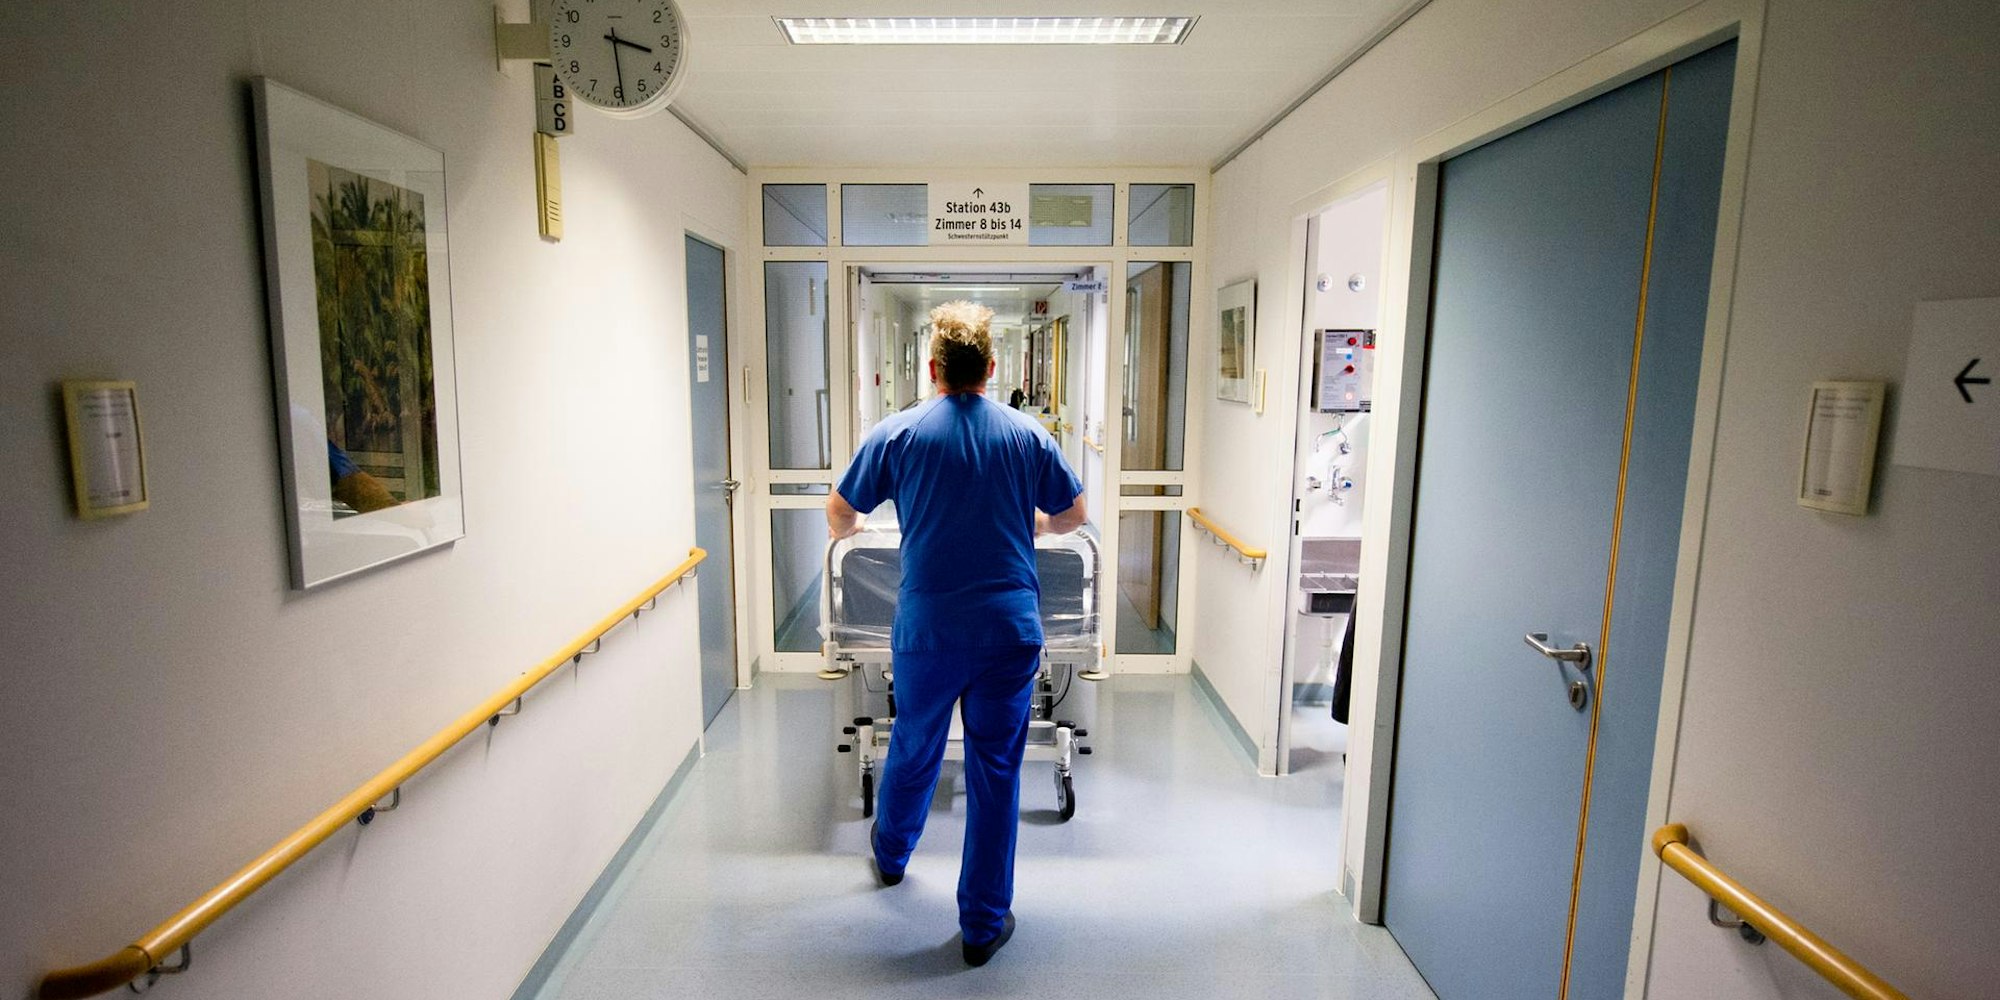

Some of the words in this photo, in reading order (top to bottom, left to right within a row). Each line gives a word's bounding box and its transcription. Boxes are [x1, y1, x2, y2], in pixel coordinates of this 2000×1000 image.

[566, 10, 580, 24] 10
[653, 10, 662, 23] 2
[562, 35, 571, 47] 9
[660, 35, 670, 47] 3
[570, 61, 579, 73] 8
[653, 62, 663, 73] 4
[589, 79, 598, 91] 7
[637, 79, 647, 92] 5
[613, 86, 623, 98] 6
[946, 201, 986, 213] Station
[989, 201, 1011, 213] 43b
[935, 218, 976, 230] Zimmer
[980, 219, 987, 230] 8
[991, 218, 1006, 230] bis
[1010, 218, 1022, 230] 14
[948, 232, 1008, 240] Schwesternstützpunkt
[1072, 282, 1096, 290] Zimmer
